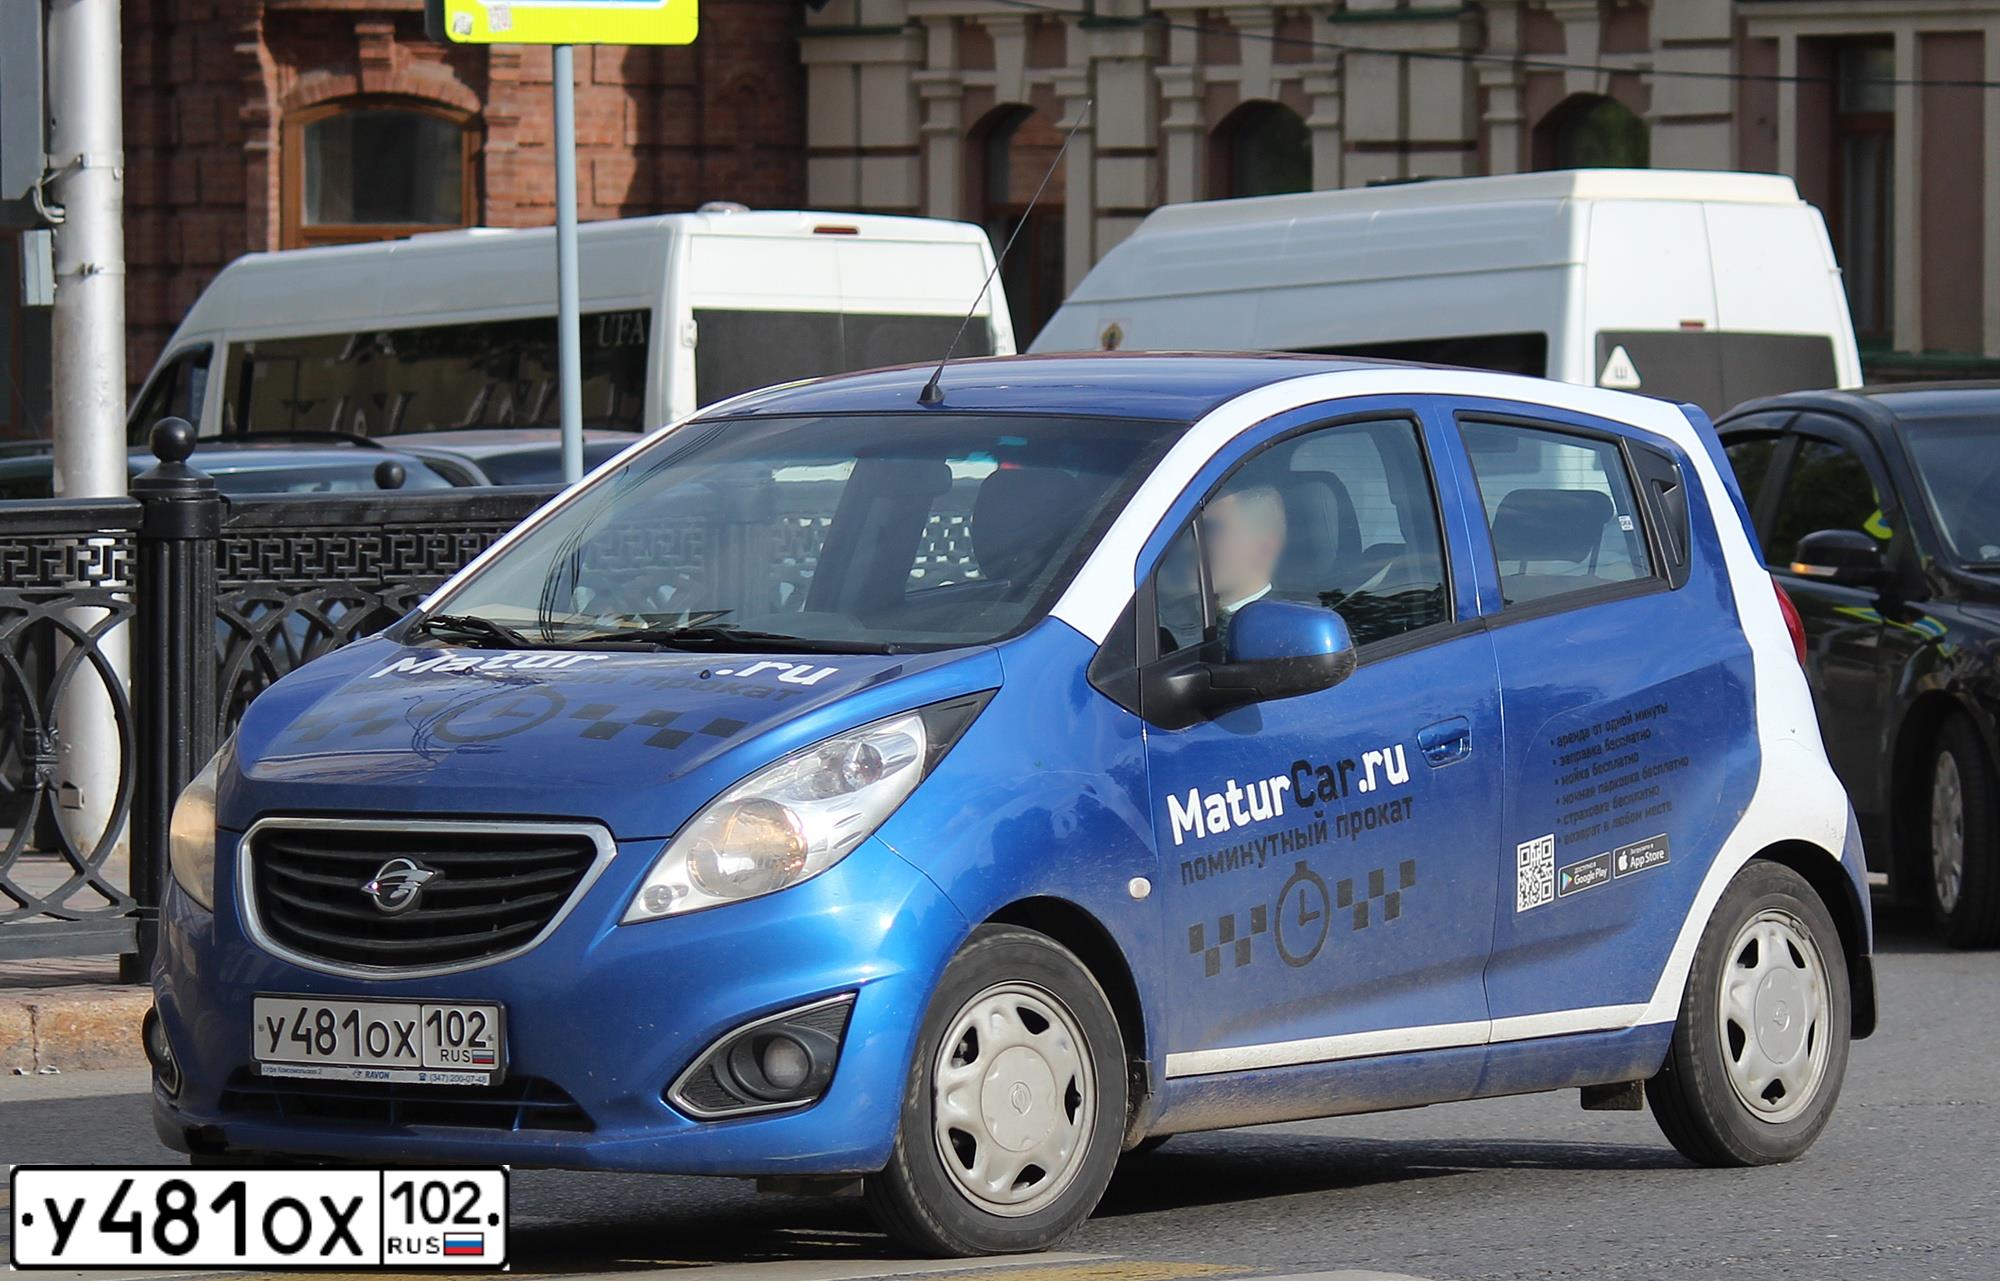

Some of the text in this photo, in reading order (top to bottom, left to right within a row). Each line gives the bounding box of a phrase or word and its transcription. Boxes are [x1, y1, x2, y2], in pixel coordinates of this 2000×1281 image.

[599, 313, 644, 347] UFA
[1557, 702, 1670, 748] аренда от одной минуты
[1559, 728, 1652, 767] заправка бесплатно
[1561, 752, 1640, 785] мойка бесплатно
[1562, 756, 1689, 806] ночная парковка бесплатно
[1167, 743, 1410, 847] MaturCar.ru
[1563, 785, 1660, 825] страховка бесплатно
[1180, 797, 1413, 886] поминутный прокат
[1630, 850, 1665, 868] App Store
[1574, 867, 1608, 886] Google Play
[427, 1009, 488, 1048] 102
[365, 1070, 391, 1080] RAVON
[440, 1050, 471, 1063] RUS
